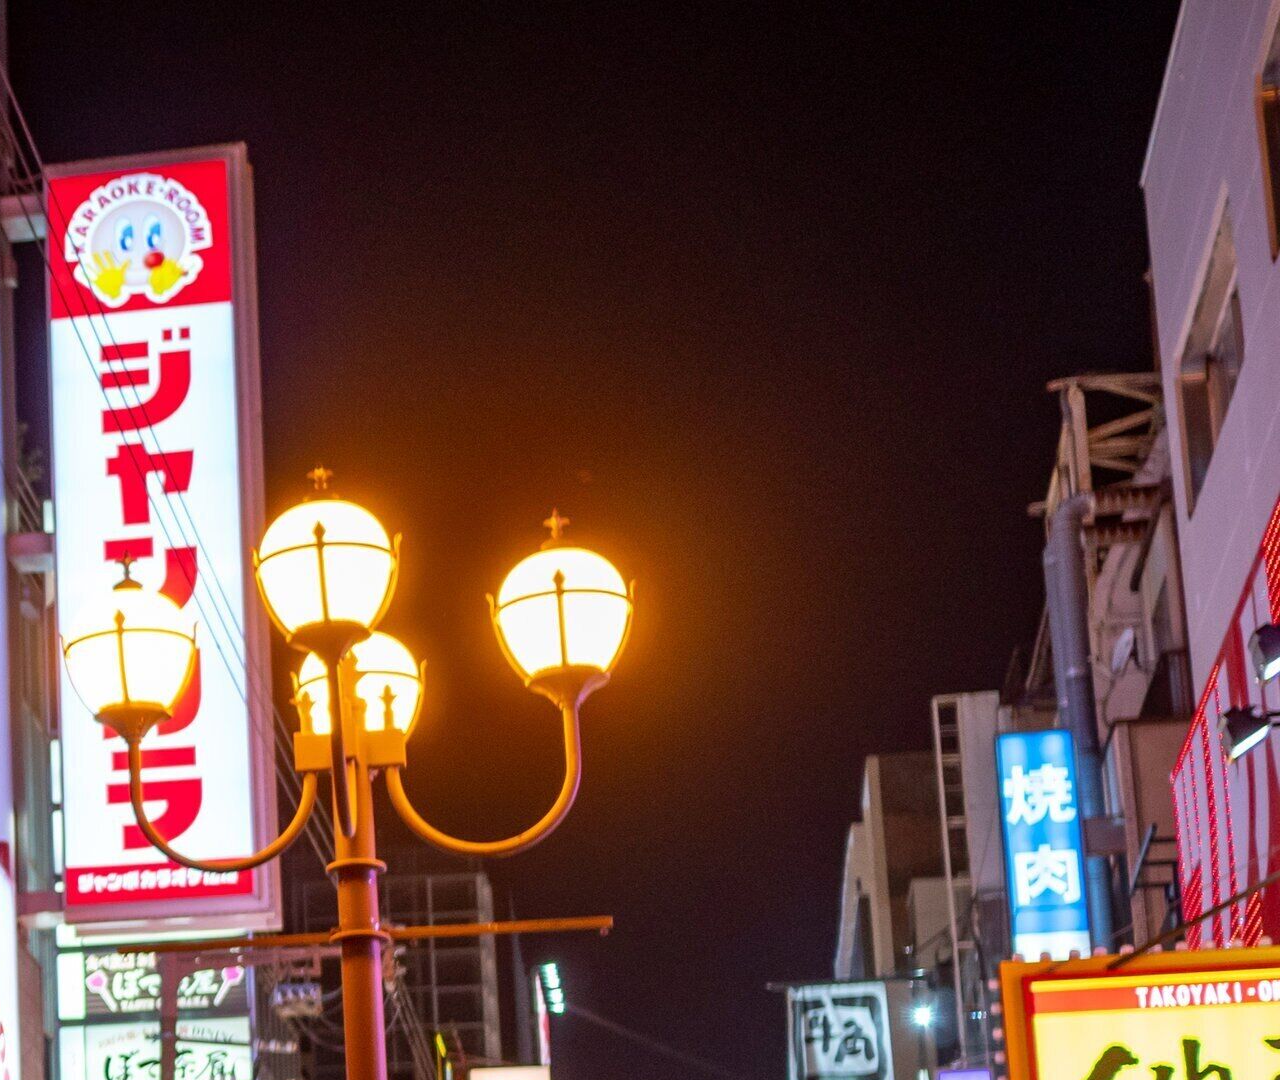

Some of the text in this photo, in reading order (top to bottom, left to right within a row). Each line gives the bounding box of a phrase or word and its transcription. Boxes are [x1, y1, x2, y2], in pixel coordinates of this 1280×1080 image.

[99, 327, 203, 850] ジャンラ
[1003, 763, 1082, 906] 焼肉
